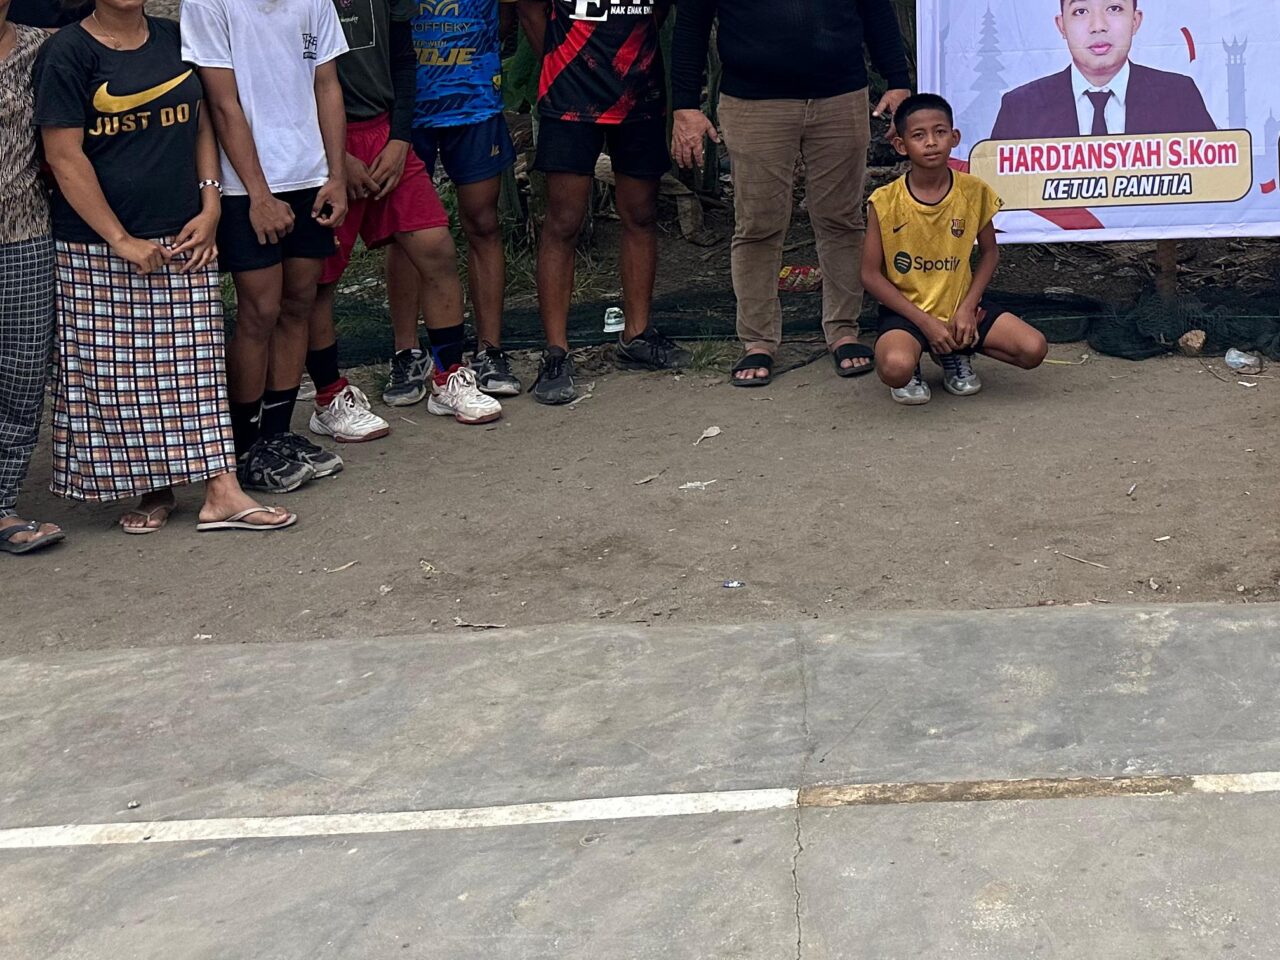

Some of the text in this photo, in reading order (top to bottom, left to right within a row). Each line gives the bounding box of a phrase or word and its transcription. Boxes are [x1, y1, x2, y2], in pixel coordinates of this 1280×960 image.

[89, 103, 190, 135] JUST DO
[998, 138, 1237, 173] HARDIANSYAH S.Kom
[1044, 174, 1191, 199] KETUA PANITIA
[913, 255, 961, 273] Spotify
